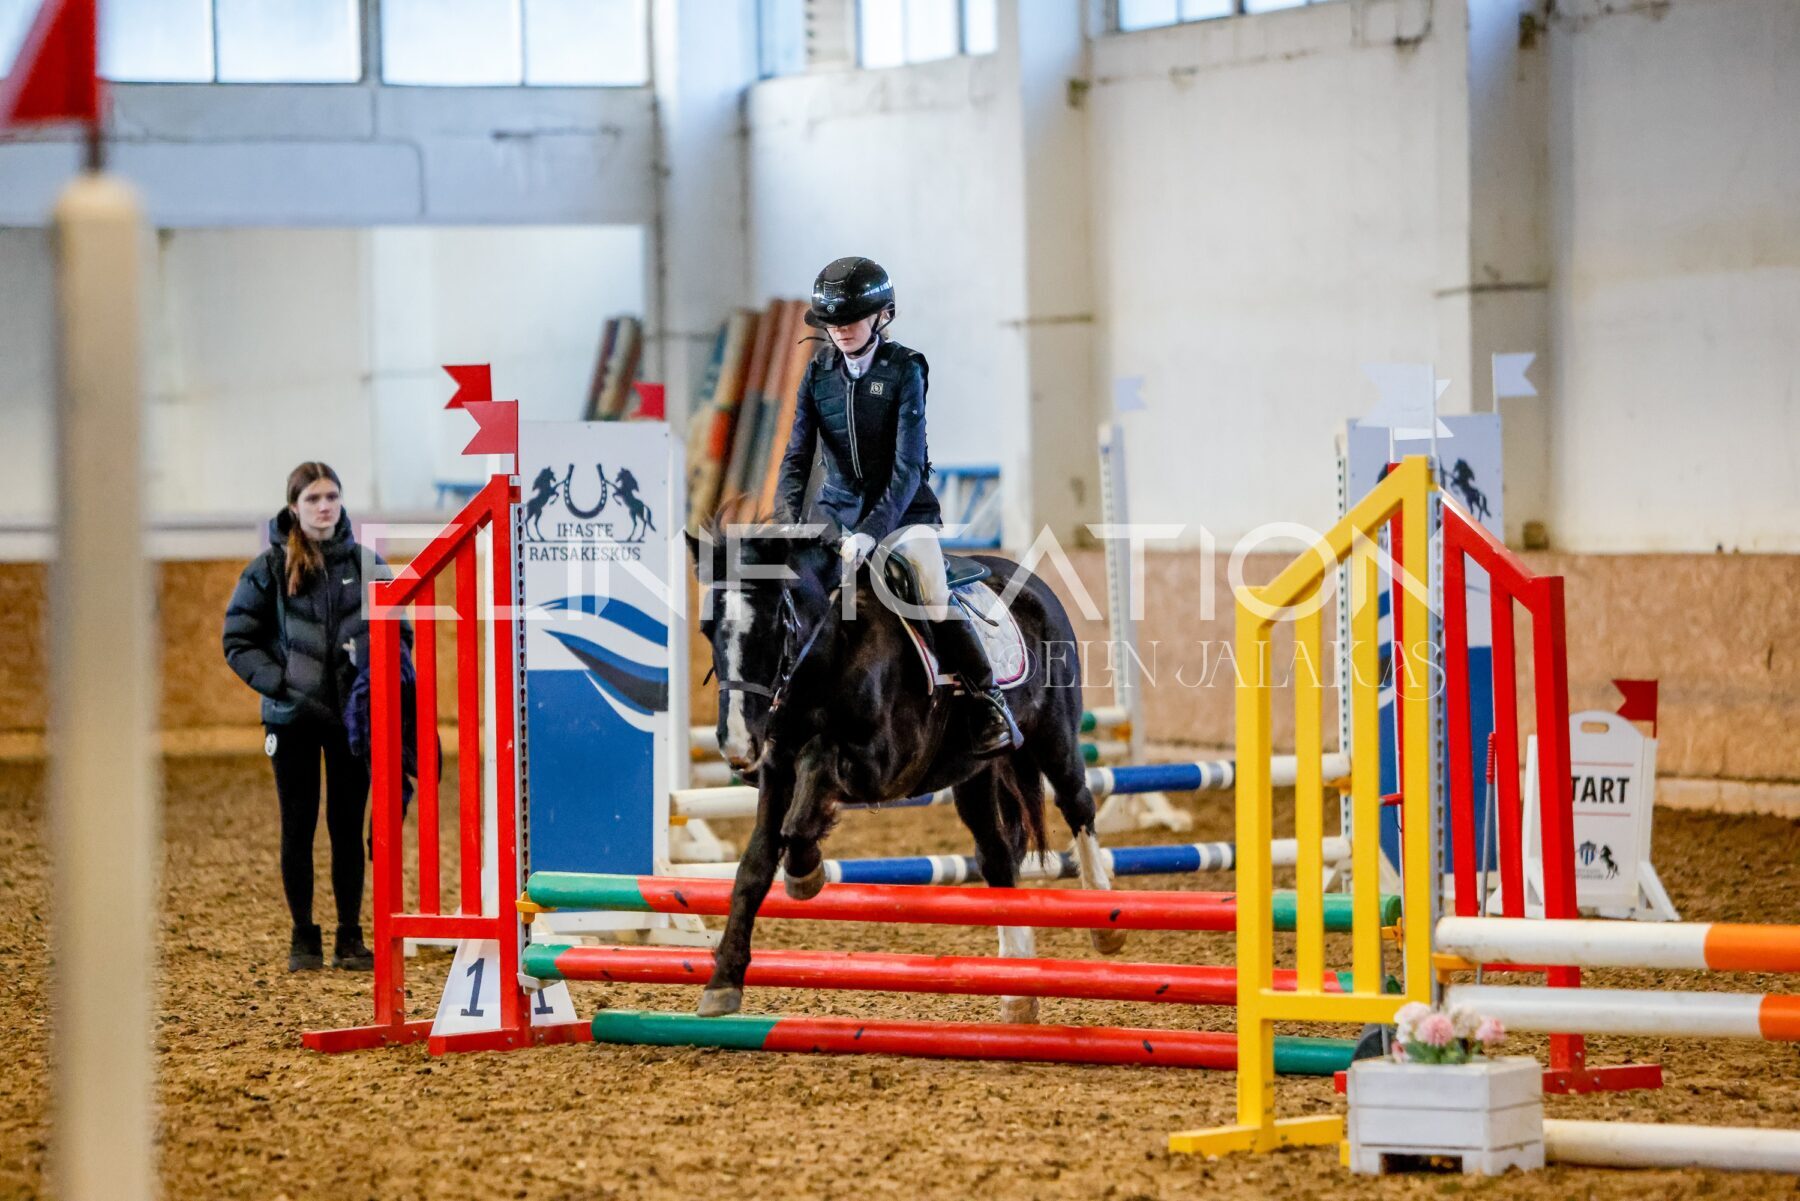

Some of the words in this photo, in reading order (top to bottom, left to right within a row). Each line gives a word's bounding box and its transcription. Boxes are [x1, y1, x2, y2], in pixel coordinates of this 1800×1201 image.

[557, 523, 614, 537] IHASTE
[529, 547, 641, 561] RATSAKESKUS
[1571, 776, 1630, 804] TART
[460, 957, 485, 1017] 1
